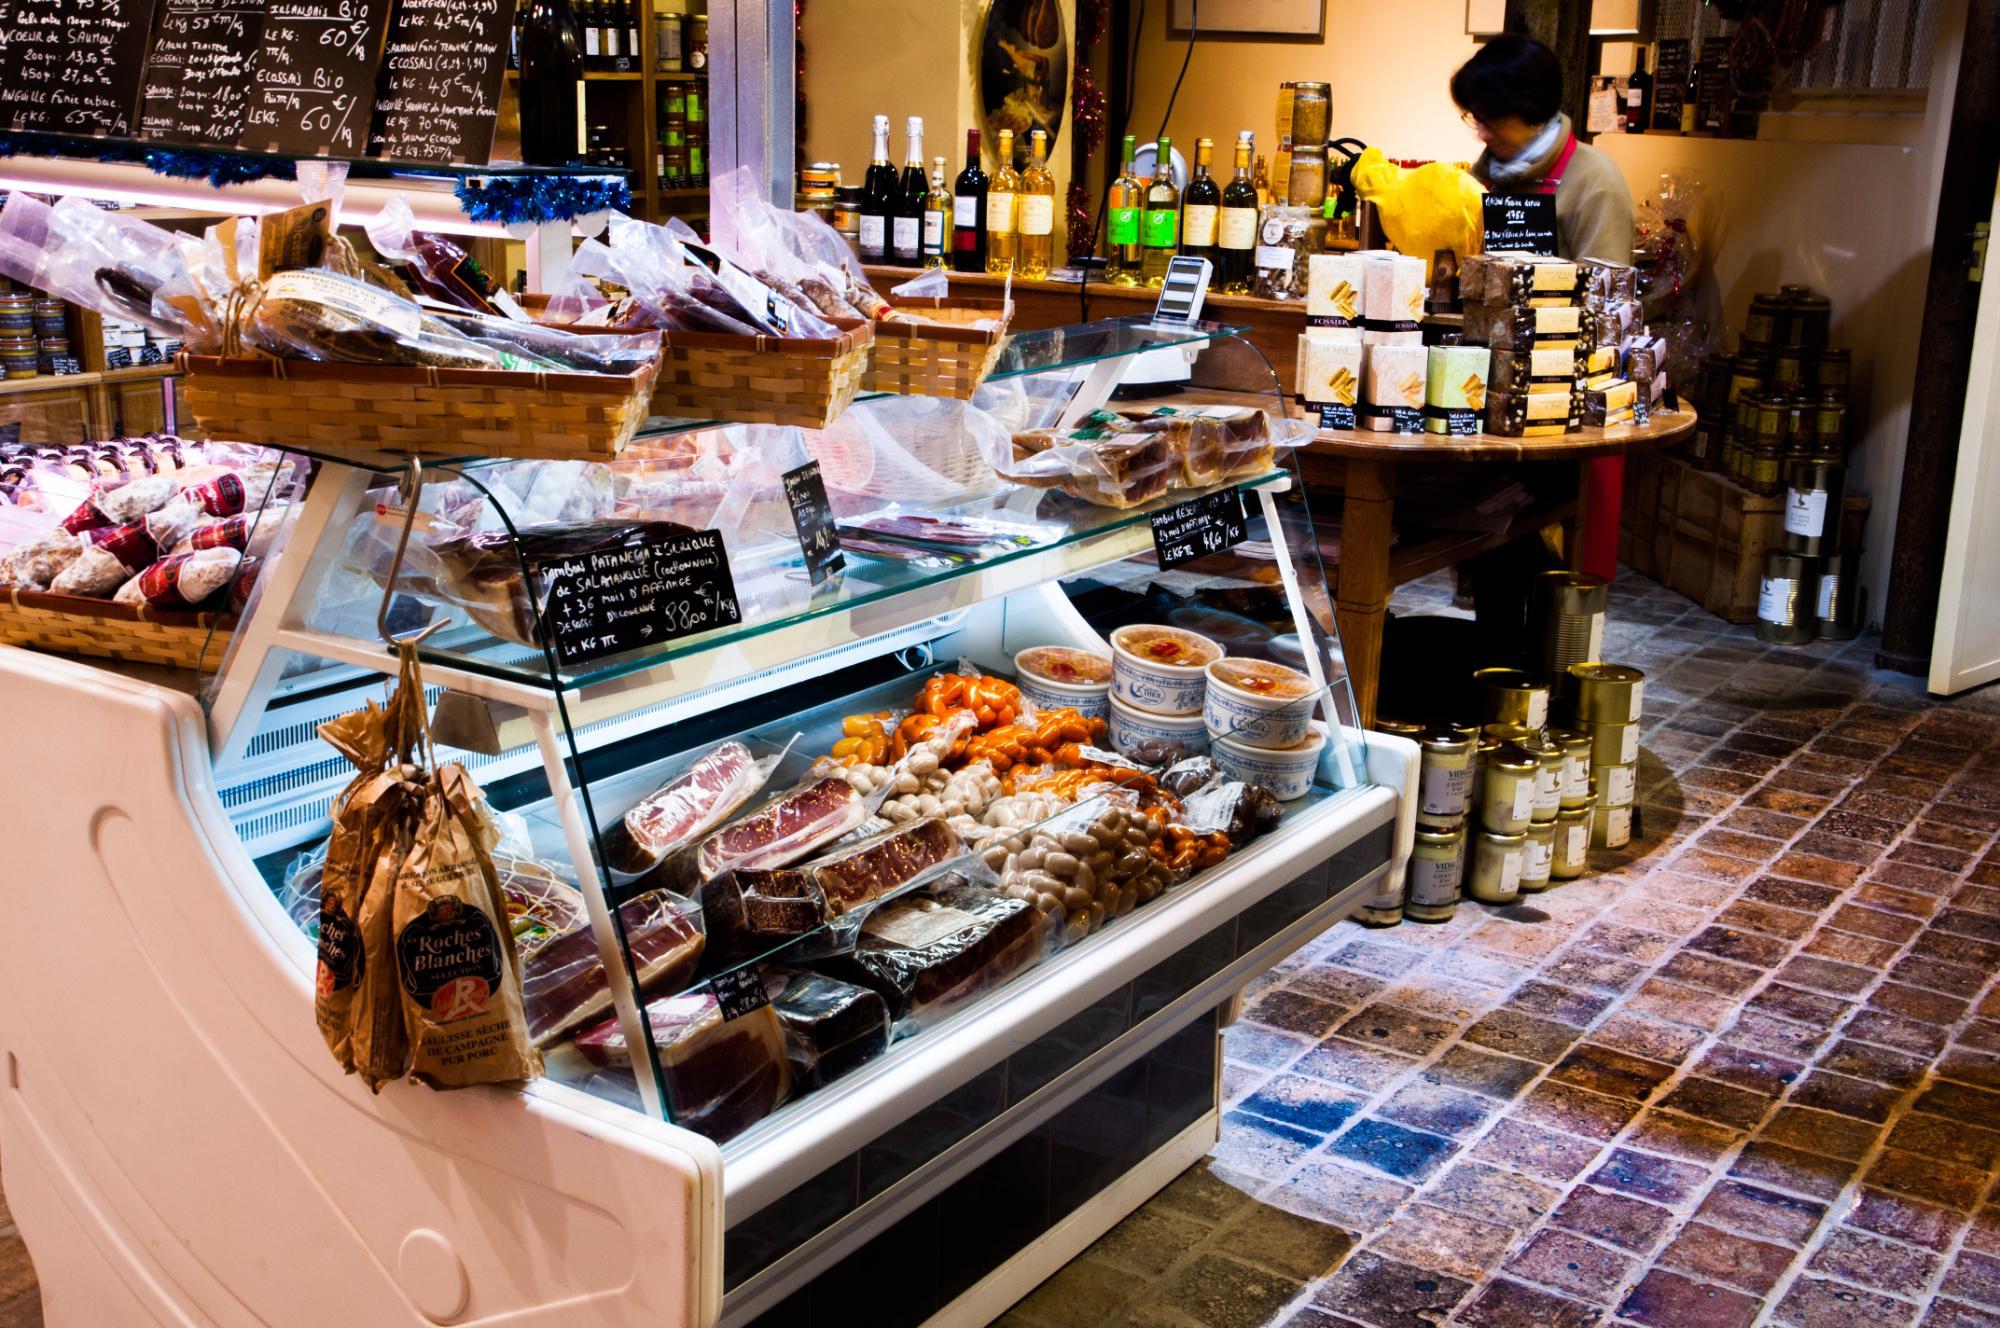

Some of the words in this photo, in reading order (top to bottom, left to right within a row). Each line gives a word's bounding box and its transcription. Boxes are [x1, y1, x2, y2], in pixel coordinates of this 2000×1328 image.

[46, 30, 60, 44] de
[264, 28, 279, 42] LE
[319, 28, 348, 47] 60
[427, 76, 452, 98] 48
[300, 106, 331, 132] 60
[1314, 317, 1350, 327] FOSSIER
[555, 585, 574, 600] de
[576, 597, 595, 616] 36
[418, 928, 484, 958] Roches
[412, 944, 494, 974] Blanches
[420, 1024, 473, 1047] SAUCISSE
[426, 1045, 446, 1057] DE
[446, 1032, 509, 1055] CAMPAGNE
[440, 1051, 466, 1067] PUR
[467, 1044, 499, 1064] PORC
